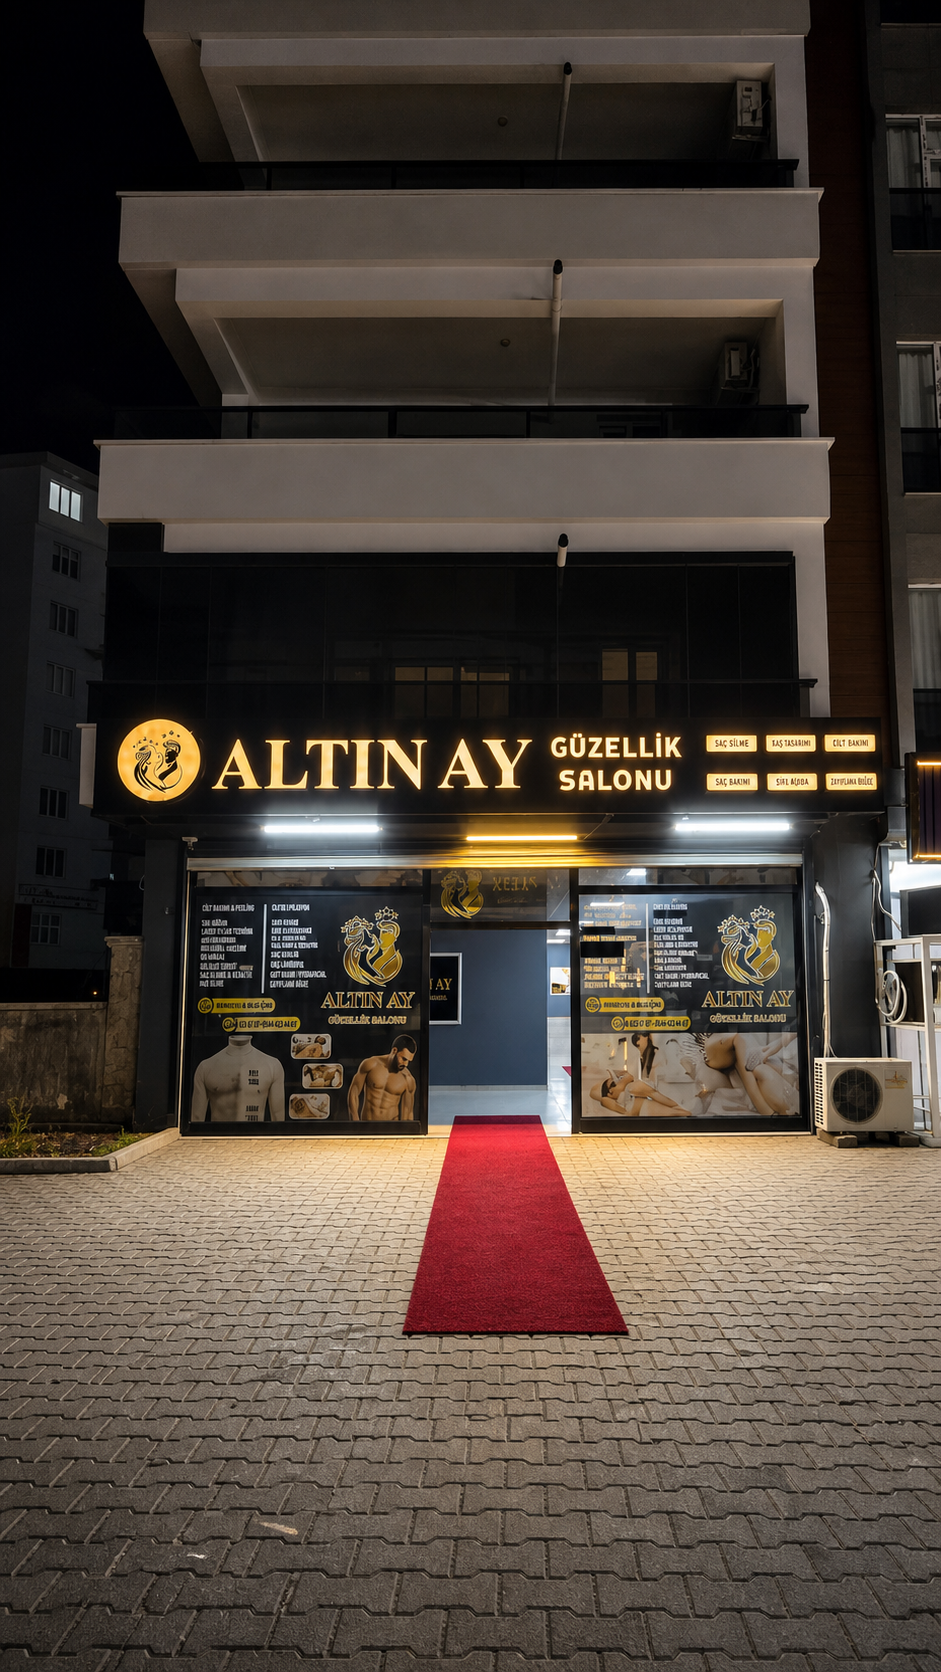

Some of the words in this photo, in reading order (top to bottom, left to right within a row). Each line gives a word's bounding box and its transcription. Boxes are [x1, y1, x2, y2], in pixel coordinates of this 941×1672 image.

[550, 732, 683, 758] GÜZELLİK
[211, 738, 428, 791] ALTIN
[437, 738, 533, 790] AY
[559, 769, 672, 791] SALONU
[320, 991, 384, 1009] ALTIN
[385, 991, 416, 1009] AY
[701, 990, 765, 1008] ALTIN
[766, 990, 795, 1008] AY
